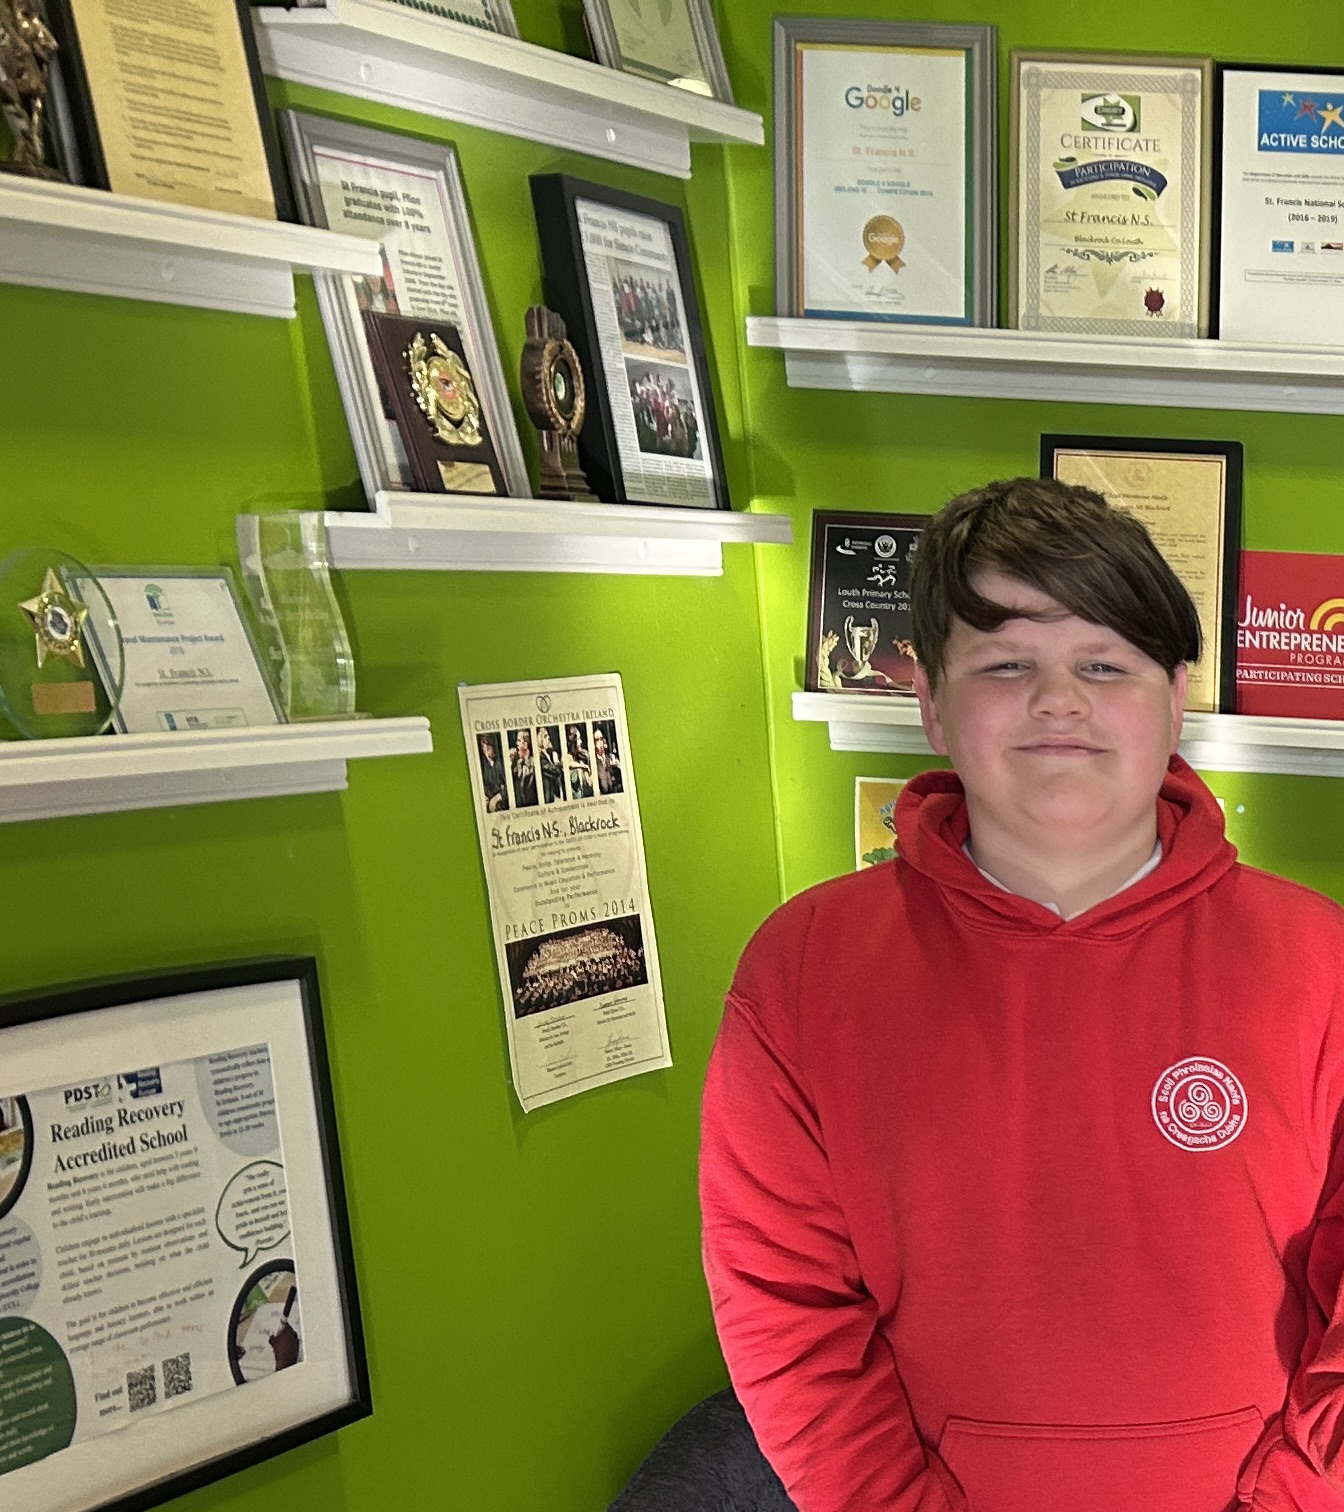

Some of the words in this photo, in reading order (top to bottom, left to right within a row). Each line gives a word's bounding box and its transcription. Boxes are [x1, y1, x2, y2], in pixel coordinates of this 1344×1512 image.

[845, 86, 921, 116] Google
[1061, 133, 1160, 152] CERTIFICATE
[1261, 133, 1306, 147] ACTIVE
[1074, 162, 1150, 177] PARTICIPATION
[1265, 197, 1274, 205] St.
[1277, 198, 1301, 206] Francis
[1304, 199, 1335, 208] National
[1064, 211, 1077, 222] St
[1080, 211, 1126, 225] Francis
[1131, 214, 1153, 226] N.S.
[838, 587, 860, 596] Louth
[862, 589, 892, 599] Primary
[843, 600, 863, 608] Cross
[865, 601, 895, 611] Country
[1238, 595, 1305, 630] Junior
[1237, 670, 1322, 683] PARTICIPATING
[475, 718, 499, 732] CROSS
[503, 716, 533, 728] BORDER
[536, 711, 579, 724] ORCHESTRA
[582, 708, 614, 718] IRELAND
[492, 827, 504, 849] St
[569, 813, 620, 836] Blackrock
[505, 918, 544, 940] PEACE
[552, 907, 596, 927] PROMS
[604, 898, 635, 917] 2014
[64, 1085, 99, 1104] PDST
[50, 1116, 114, 1143] Reading
[117, 1100, 185, 1127] Recovery
[54, 1136, 136, 1174] Accredited
[140, 1124, 188, 1152] School
